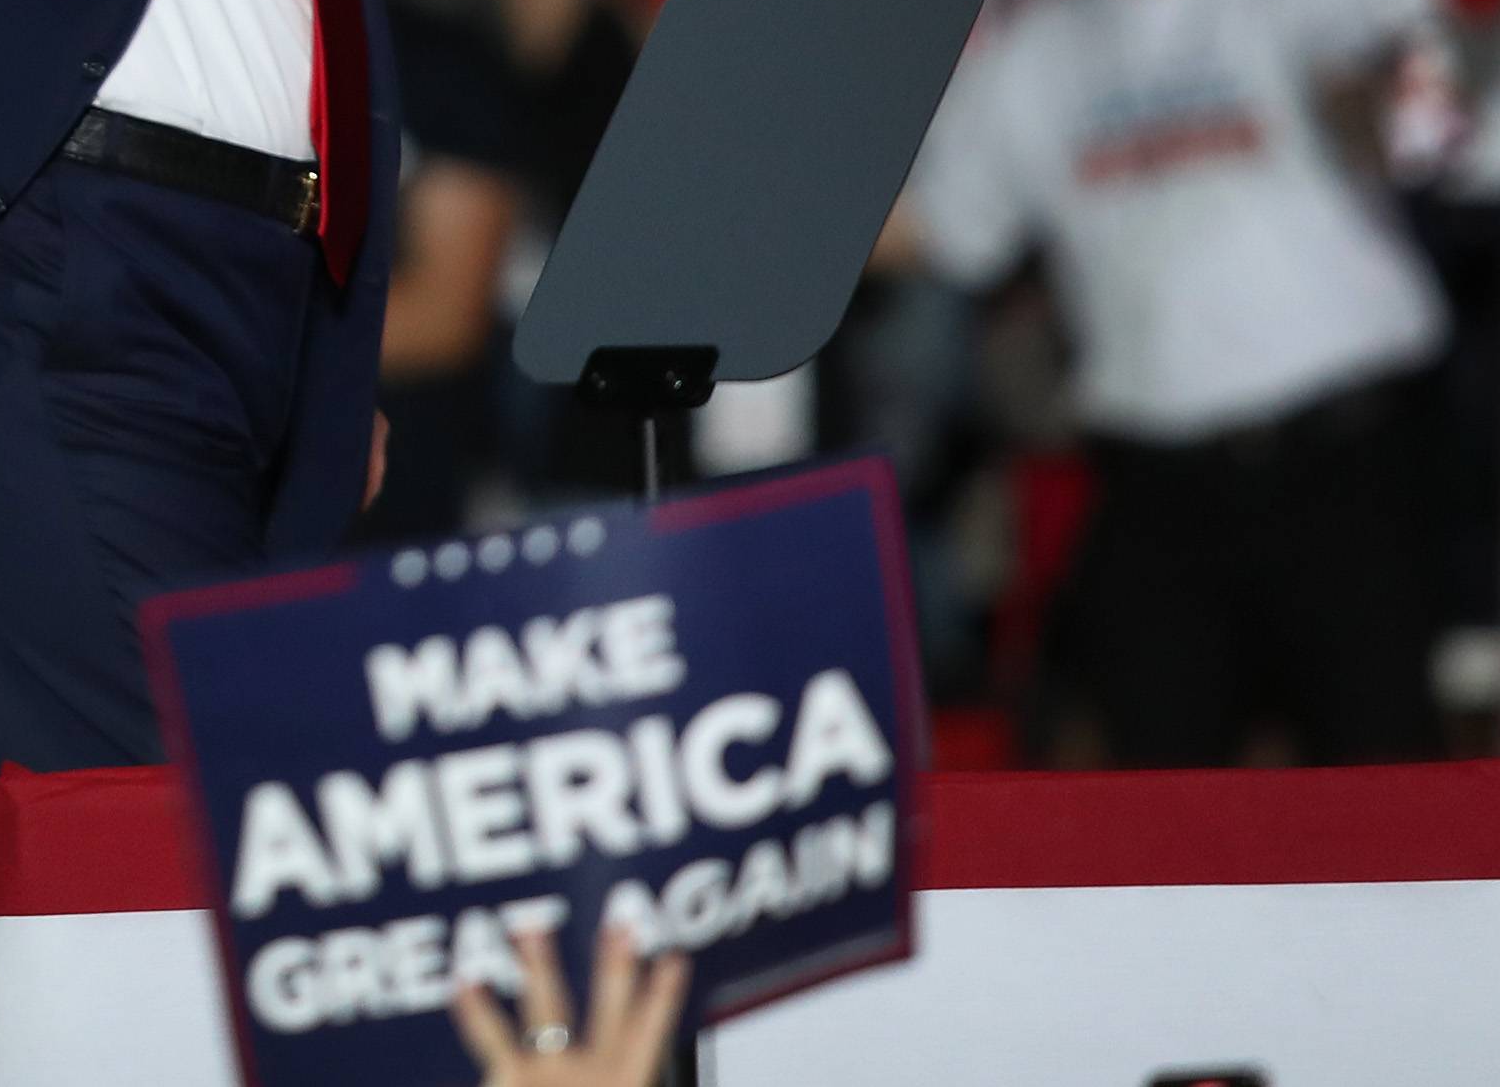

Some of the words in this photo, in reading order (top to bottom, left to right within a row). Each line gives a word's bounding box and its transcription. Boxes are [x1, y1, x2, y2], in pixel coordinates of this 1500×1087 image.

[364, 594, 687, 741] MAKE
[230, 667, 893, 919] AMERICA
[604, 801, 897, 959] AGAIN
